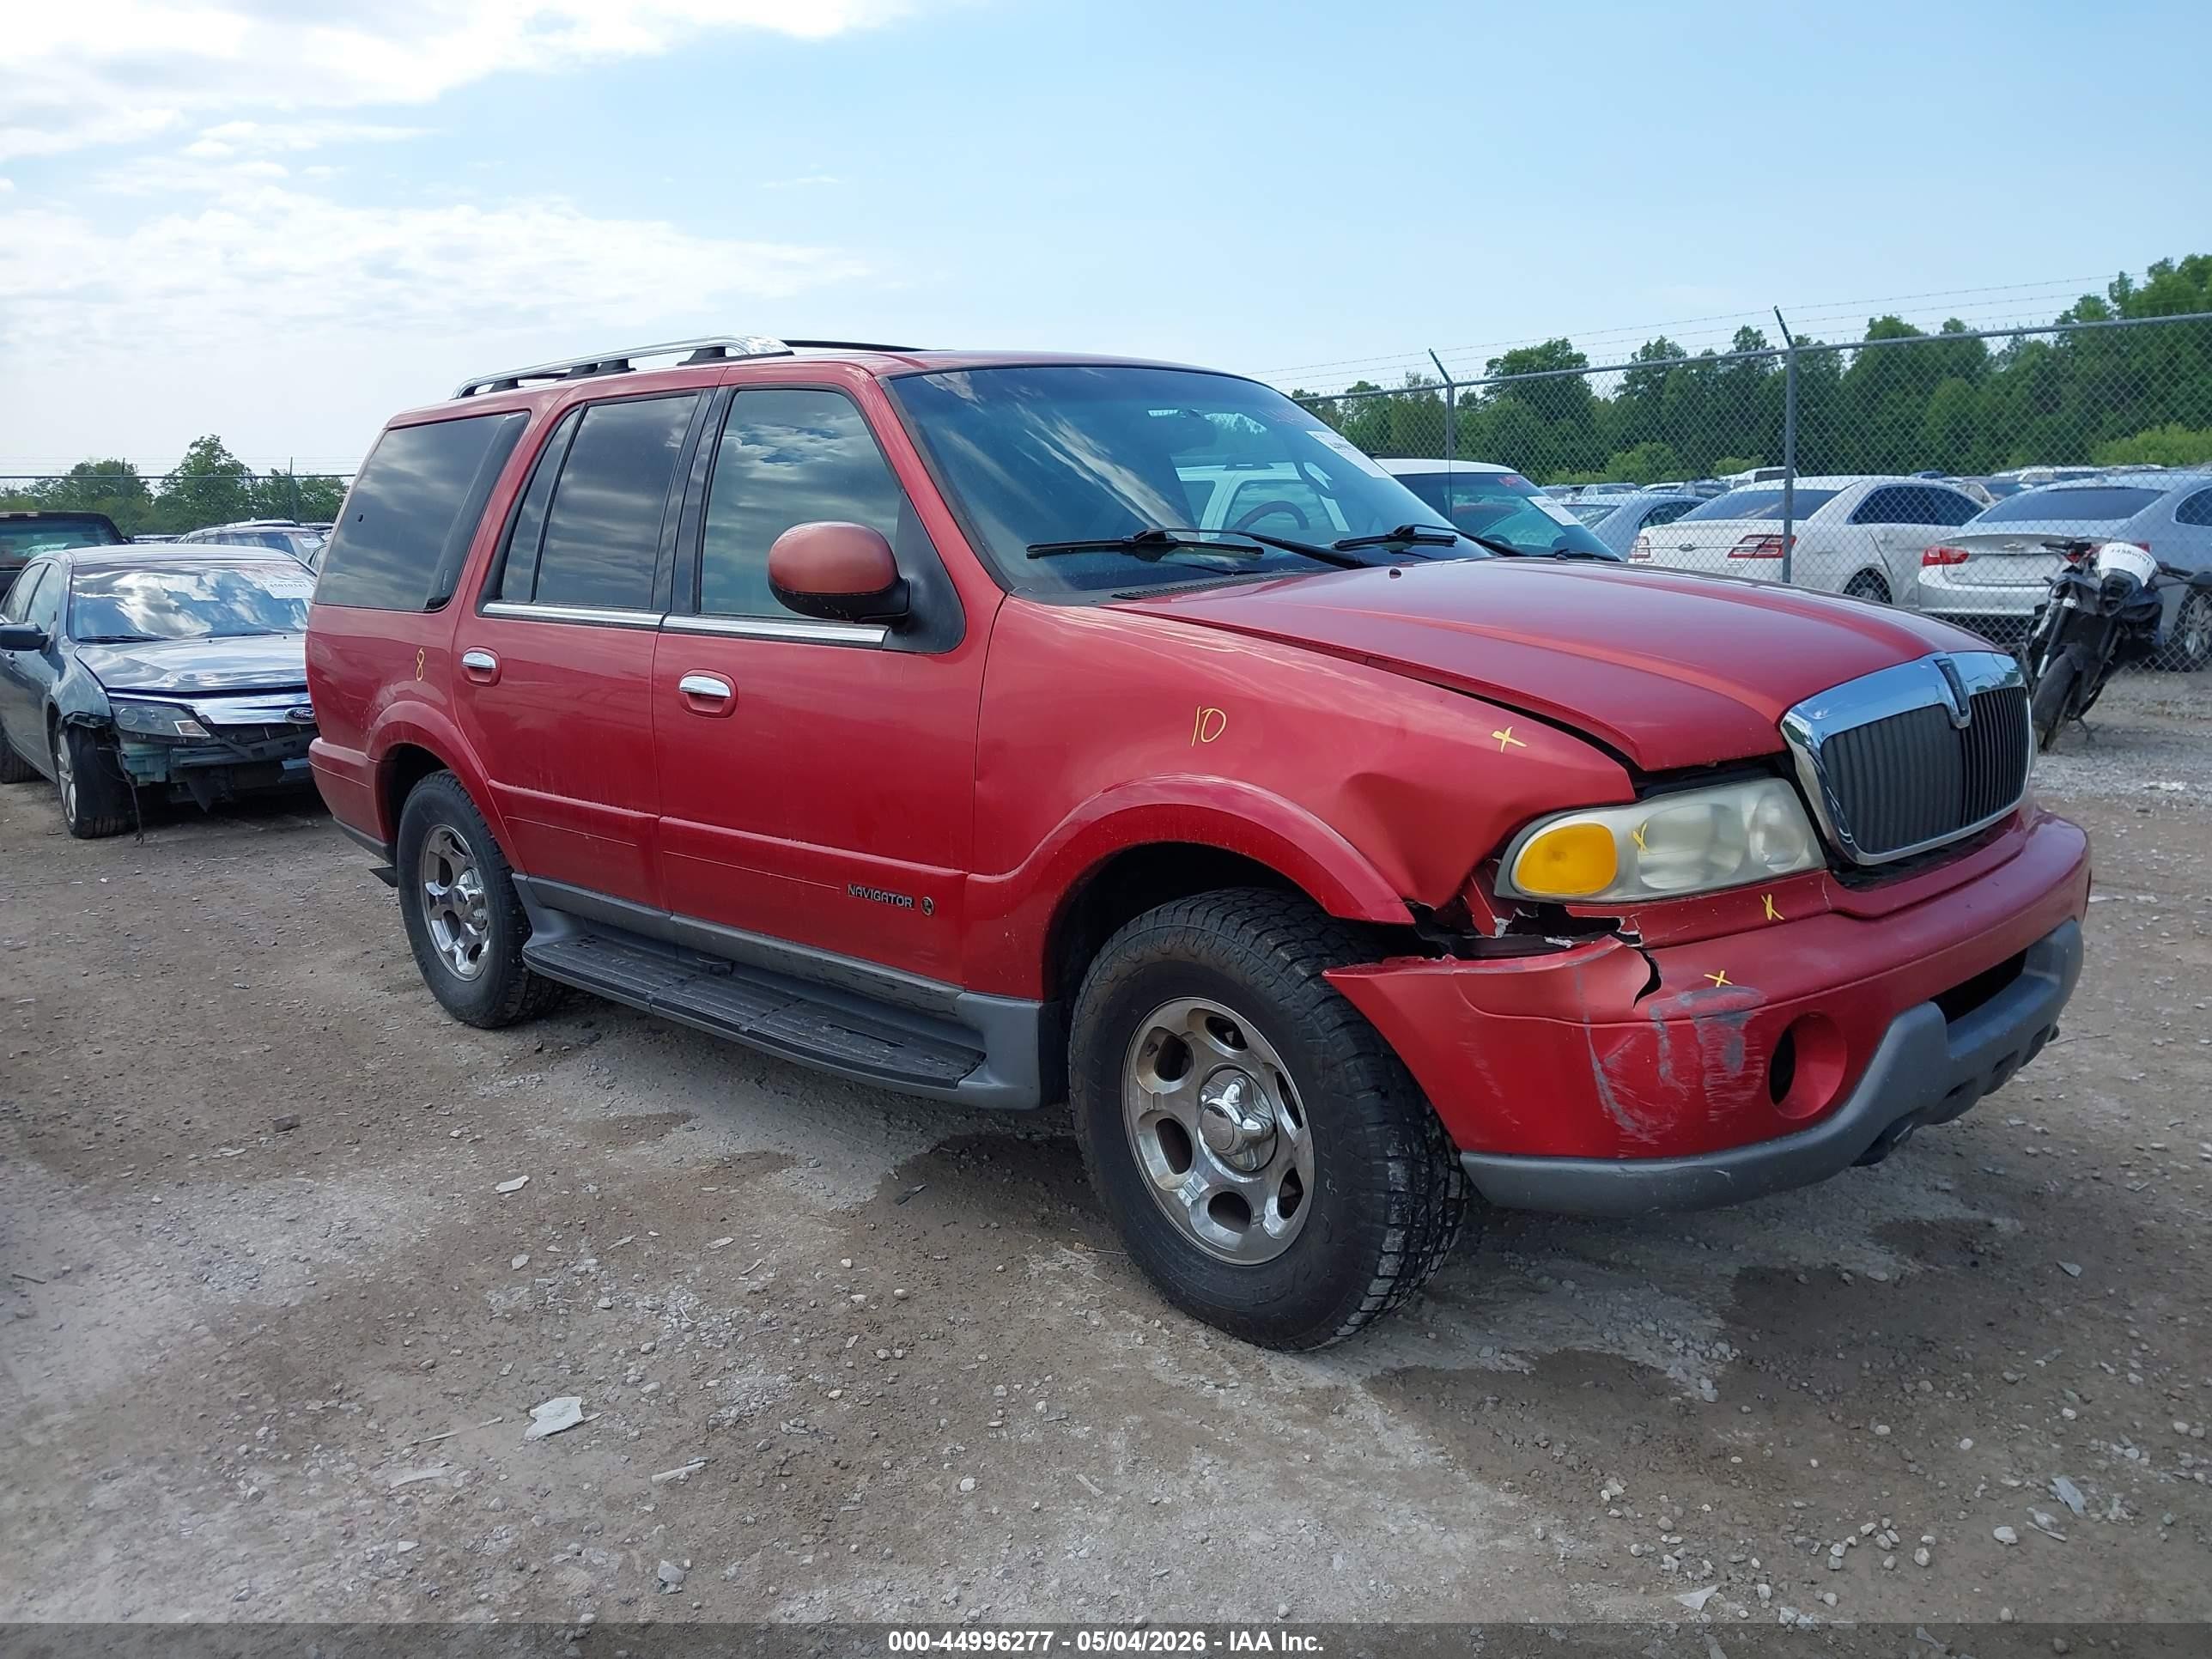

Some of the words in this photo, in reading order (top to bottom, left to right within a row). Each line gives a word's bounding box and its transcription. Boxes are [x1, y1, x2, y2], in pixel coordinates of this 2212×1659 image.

[416, 647, 425, 682] 8
[1190, 705, 1228, 748] 10
[847, 883, 915, 908] NAVIGATOR
